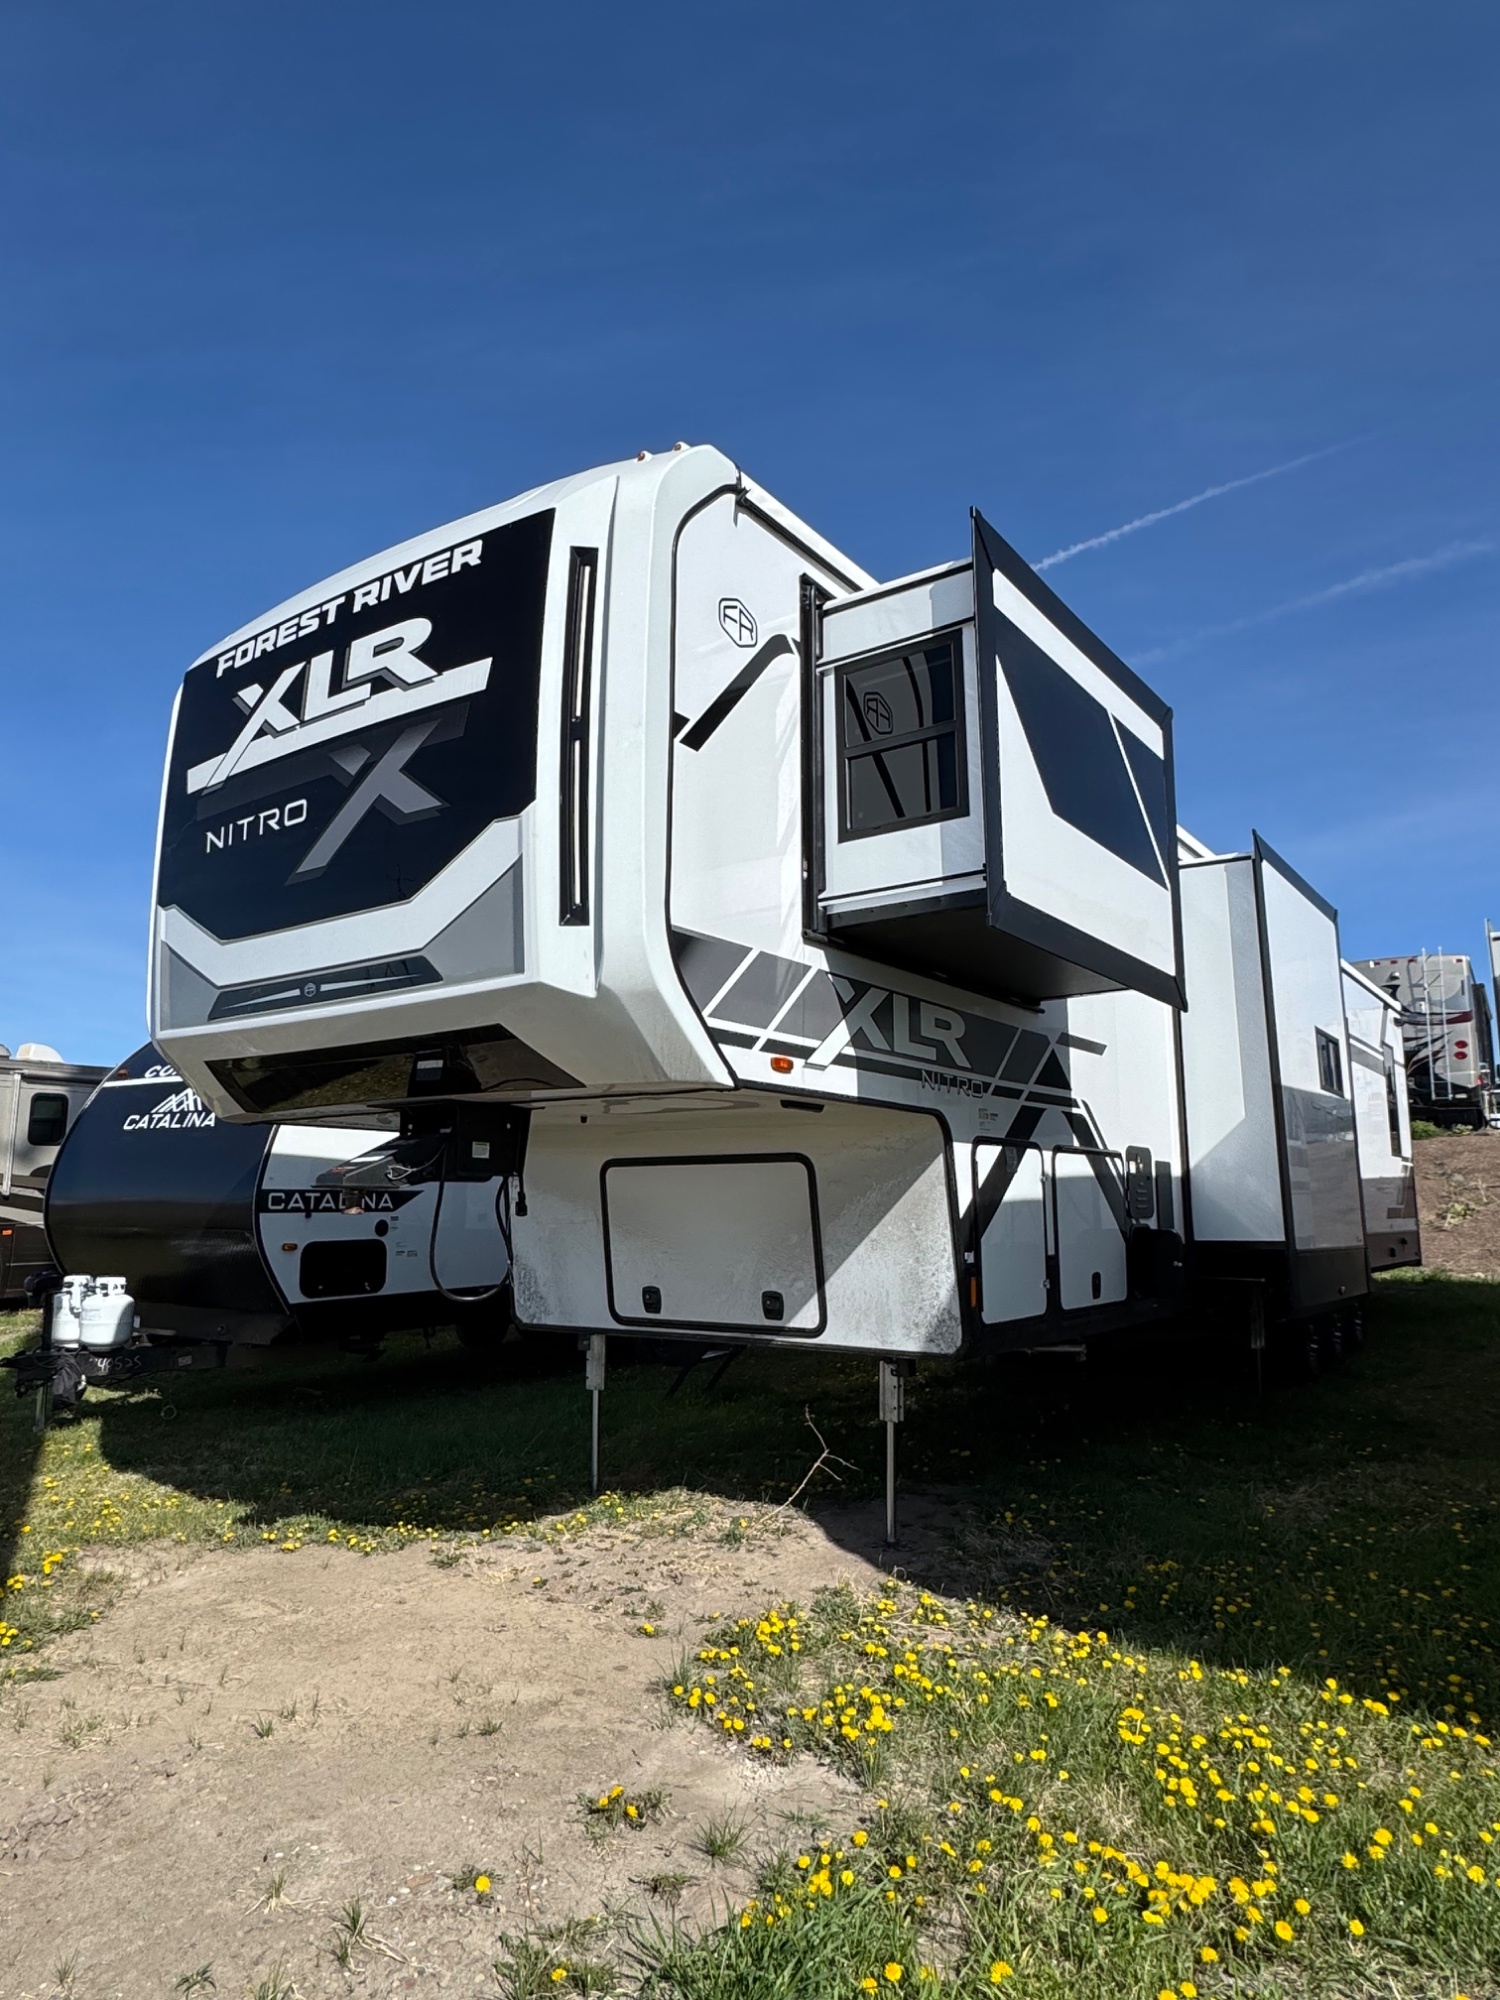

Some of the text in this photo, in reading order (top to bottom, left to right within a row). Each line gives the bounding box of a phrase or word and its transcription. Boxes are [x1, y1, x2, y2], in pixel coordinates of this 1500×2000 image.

[216, 539, 483, 678] FOREST RIVER
[202, 617, 439, 795] XLR
[205, 799, 308, 853] NITRO
[804, 973, 972, 1070] XLR
[921, 1070, 983, 1098] NITRO
[123, 1112, 215, 1130] CATALINA
[268, 1192, 394, 1210] CATALNA
